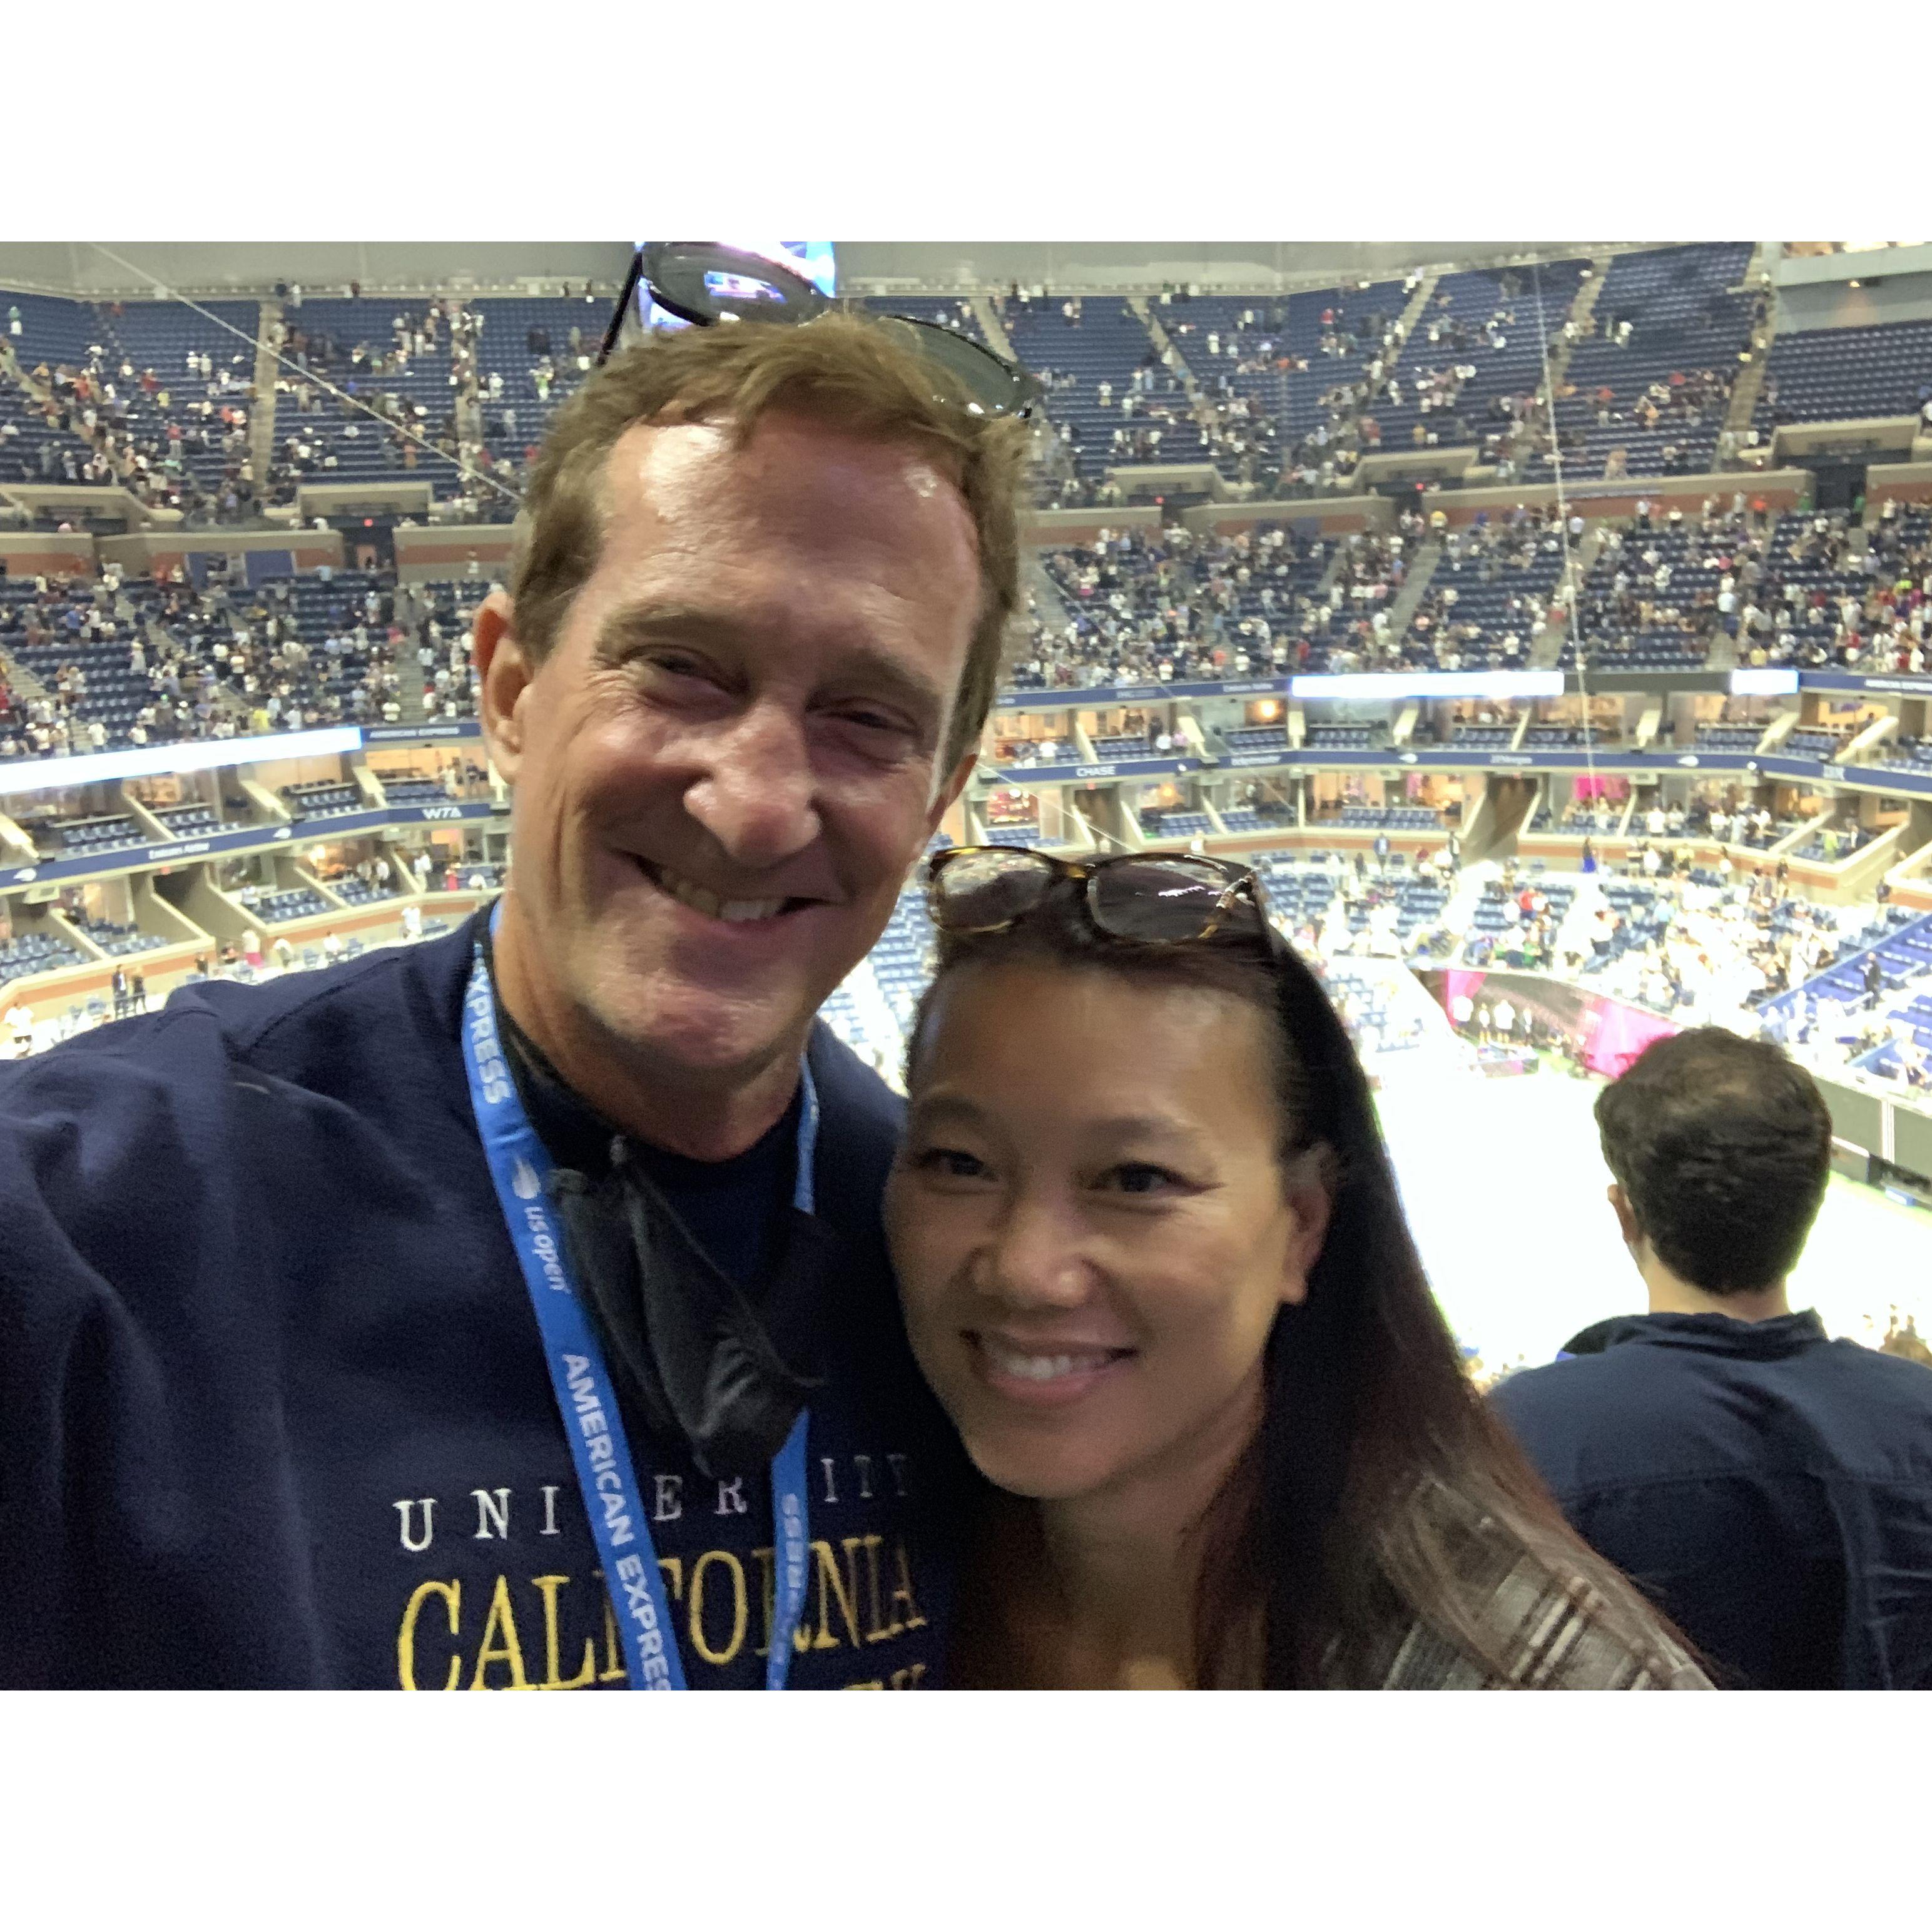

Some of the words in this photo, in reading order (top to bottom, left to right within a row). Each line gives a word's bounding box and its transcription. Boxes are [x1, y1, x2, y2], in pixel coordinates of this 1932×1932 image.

[1075, 765, 1116, 777] CHASE
[422, 806, 462, 820] WTA
[562, 1353, 636, 1547] AMERICAN
[392, 1453, 907, 1552] UNIERITY
